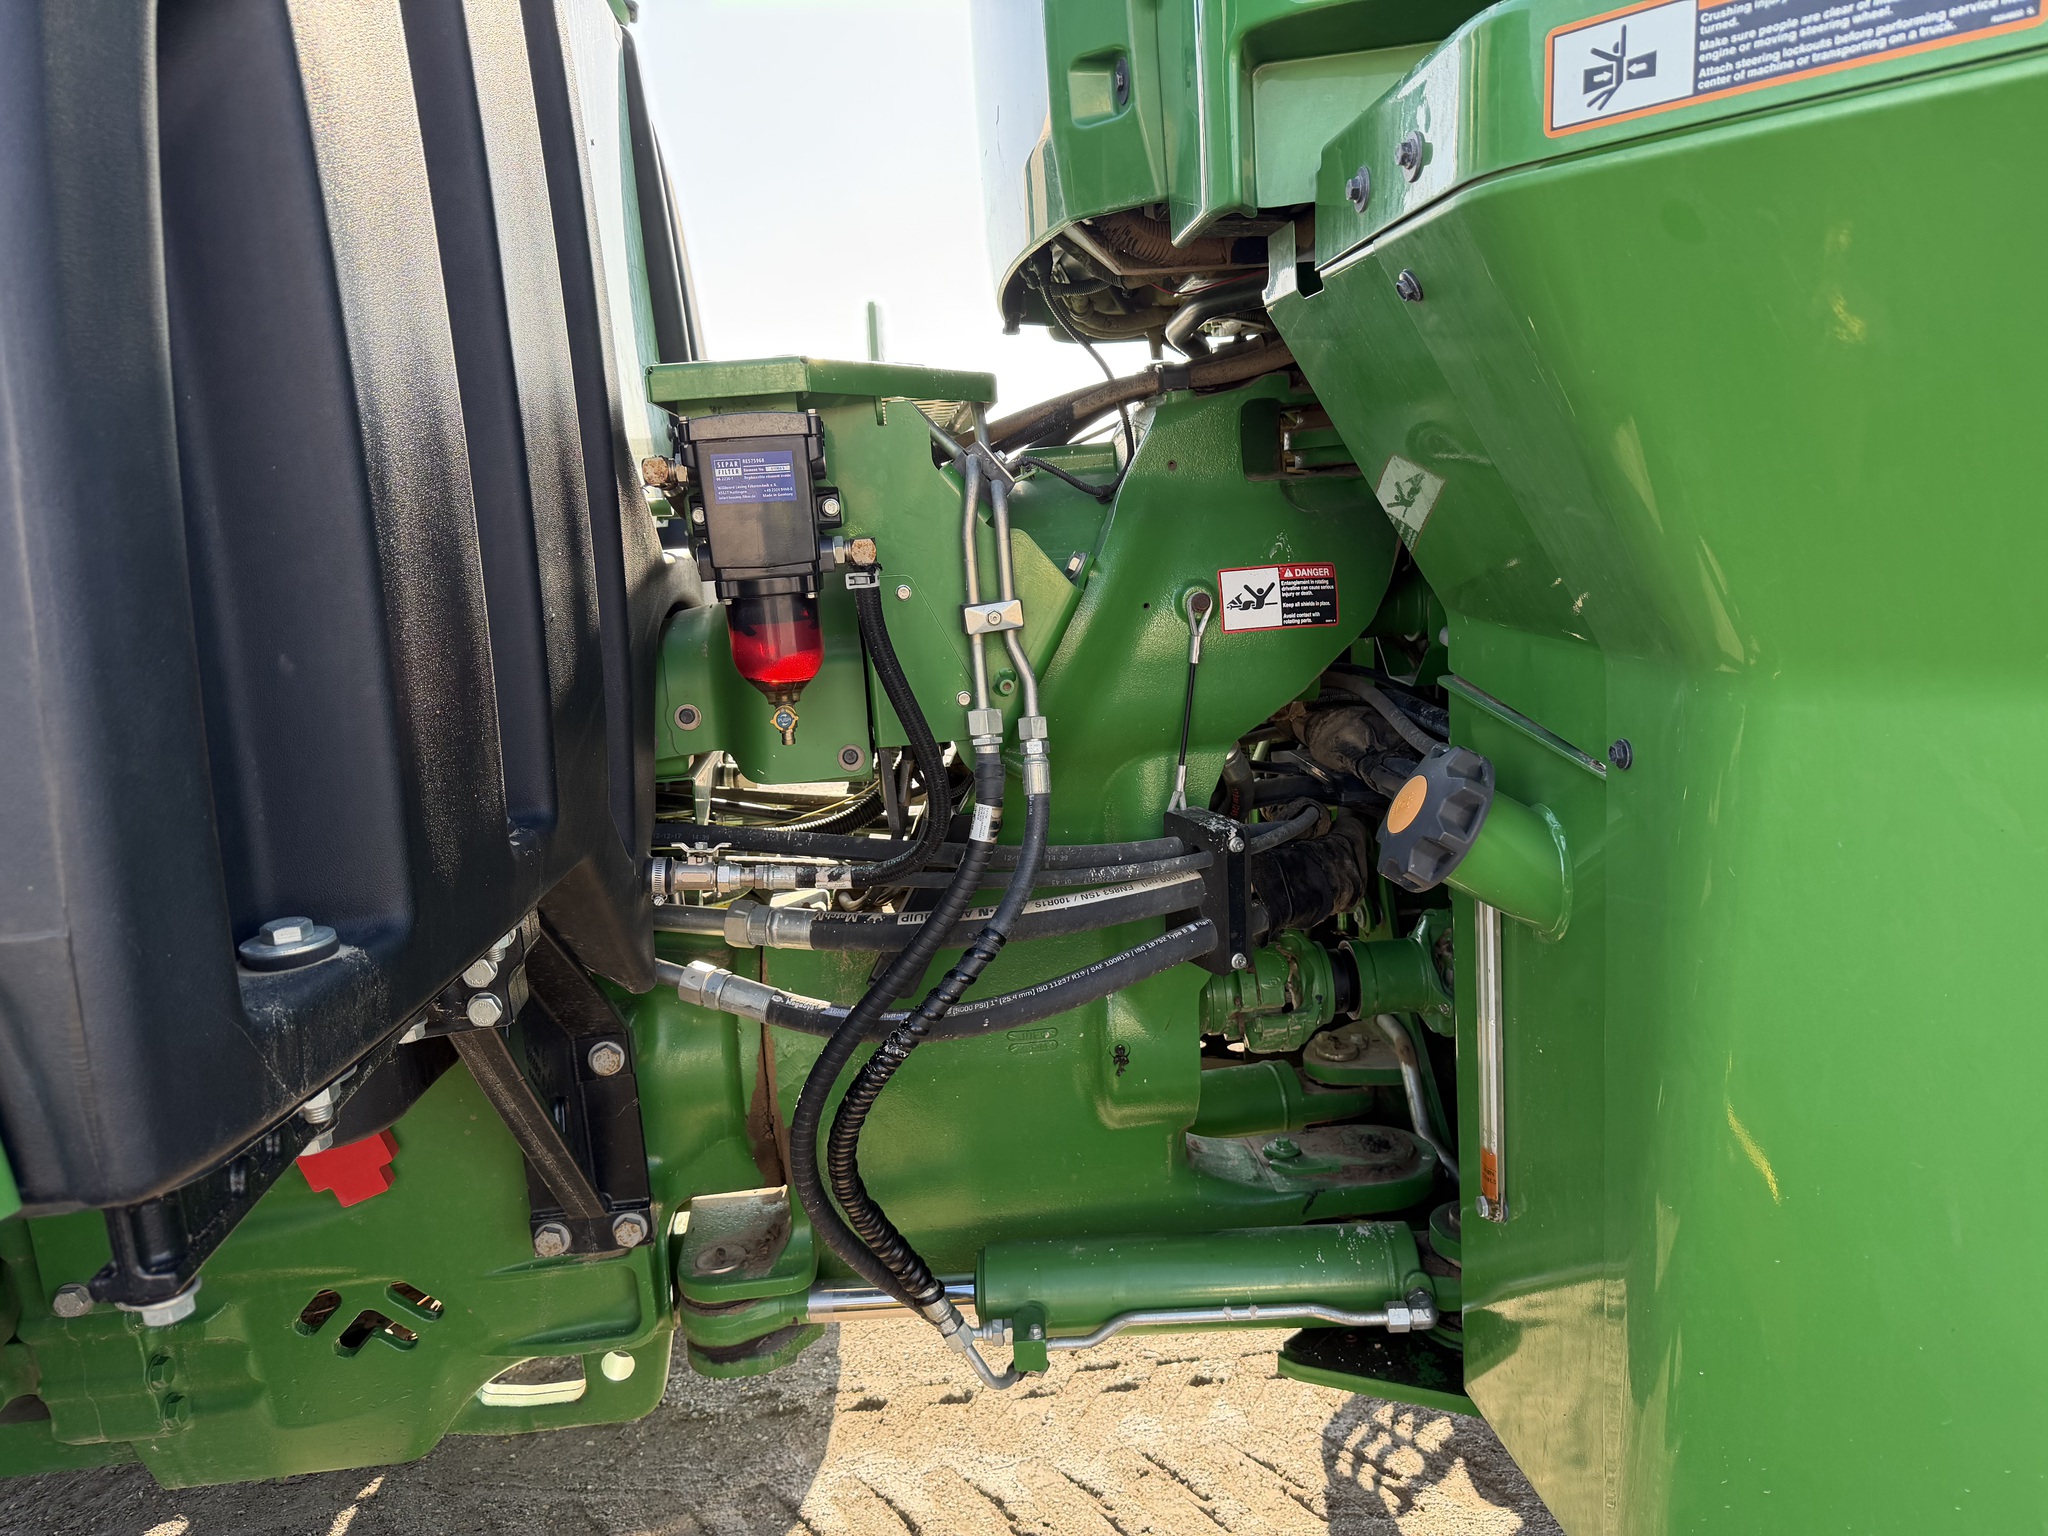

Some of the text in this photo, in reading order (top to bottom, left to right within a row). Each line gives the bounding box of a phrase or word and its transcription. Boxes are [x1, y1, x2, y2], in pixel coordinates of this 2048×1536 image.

[1699, 37, 1729, 51] Make
[1730, 29, 1757, 43] sure
[1758, 17, 1799, 38] people
[1800, 12, 1821, 25] are
[1822, 3, 1854, 20] clear
[1856, 0, 1871, 11] of
[1700, 2, 1752, 24] Crushing
[1700, 17, 1740, 35] turned.
[1698, 5, 1893, 62] engine or moving steering wheel.
[1698, 62, 1733, 79] Attach
[1735, 51, 1781, 69] steering
[1782, 37, 1833, 58] lockouts
[1834, 28, 1874, 45] before
[1875, 10, 1947, 37] performing
[1948, 0, 1999, 19] service
[1697, 20, 1958, 90] center of machine or transporting on a truck.
[1294, 568, 1330, 576] DANGER
[1035, 897, 1070, 908] 100R1S
[1081, 892, 1100, 901] 1SN
[1036, 985, 1048, 993] ISO
[1049, 976, 1070, 988] 11237
[1071, 970, 1085, 980] R19
[1090, 964, 1104, 973] SAE
[1104, 952, 1130, 967] 100R19
[1134, 946, 1146, 954] ISO
[1146, 936, 1168, 948] 18752
[1167, 931, 1182, 940] Type
